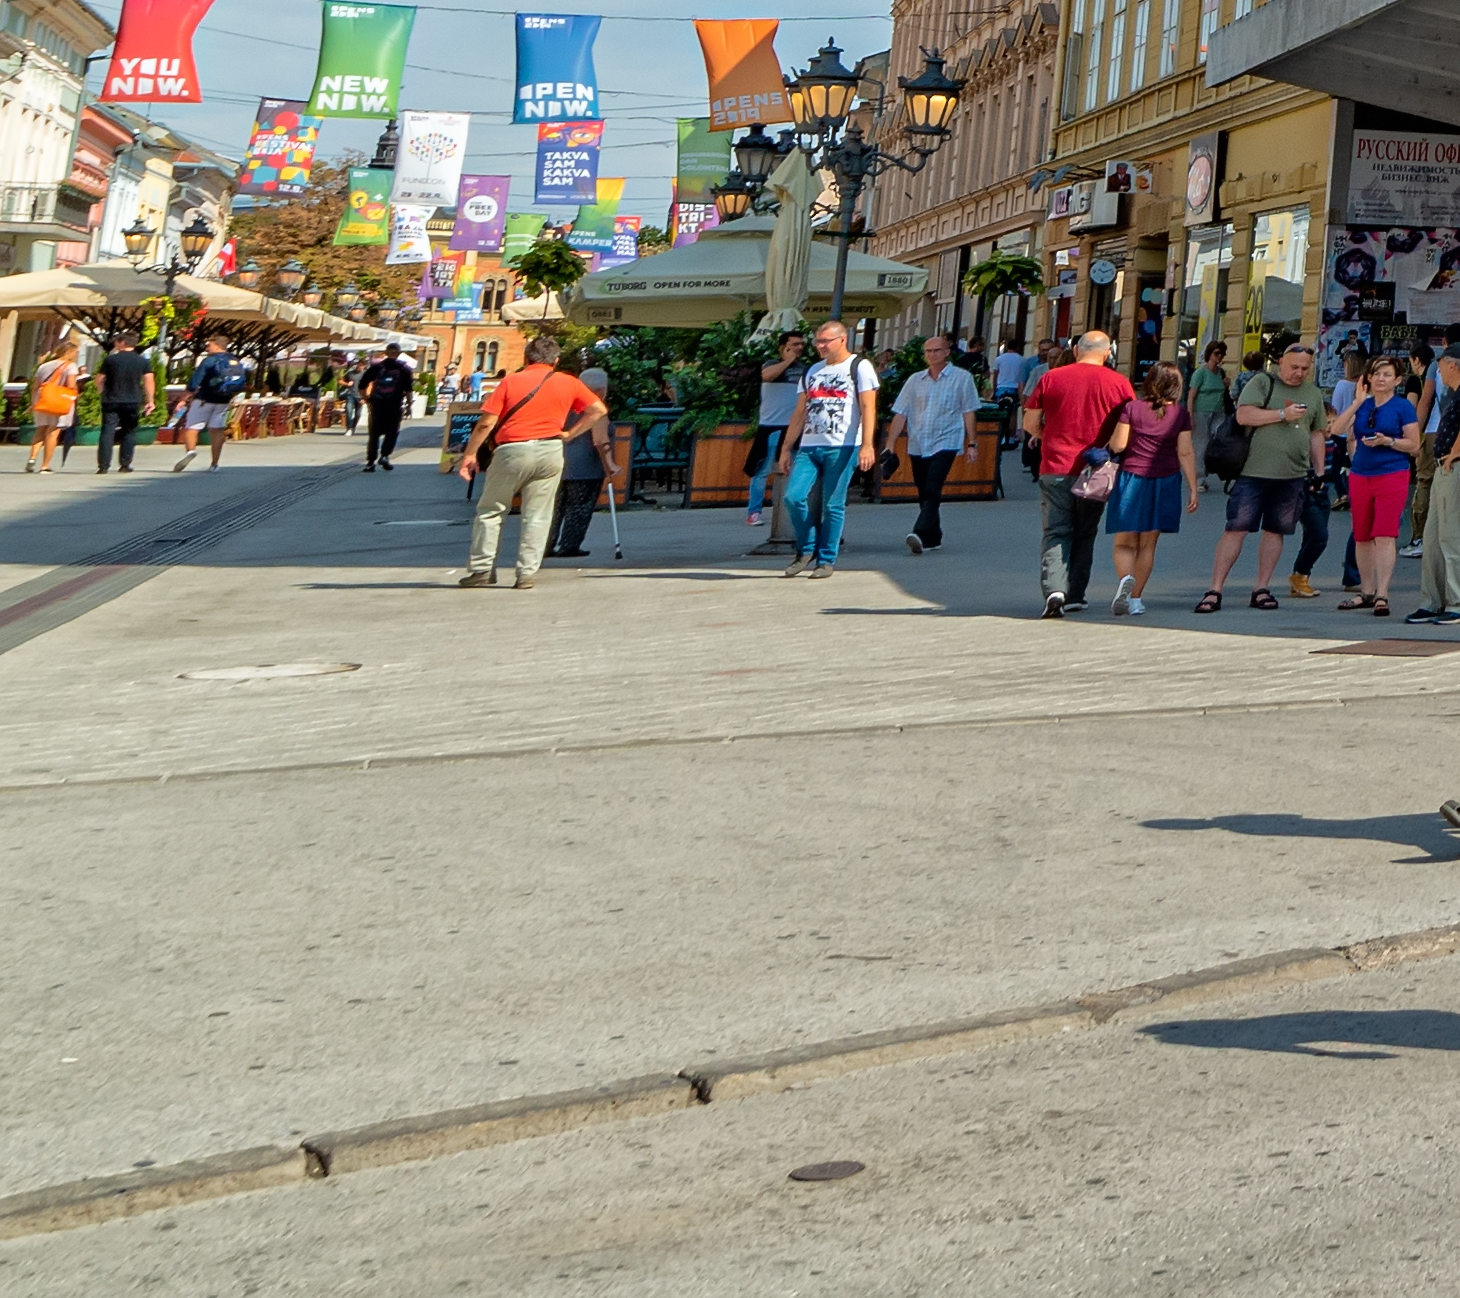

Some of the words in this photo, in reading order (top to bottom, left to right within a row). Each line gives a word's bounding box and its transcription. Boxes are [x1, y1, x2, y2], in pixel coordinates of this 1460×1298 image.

[119, 57, 181, 76] YOU
[109, 76, 190, 97] NOW.
[319, 74, 390, 94] NEW
[519, 82, 594, 101] OPEN
[316, 92, 391, 113] NOW.
[524, 100, 593, 118] NOW.
[712, 91, 784, 112] OPENS
[713, 107, 761, 126] 2019
[544, 151, 590, 161] TAKVA
[1356, 137, 1430, 162] РУССКИЙ
[542, 168, 591, 178] KAKVA
[543, 160, 576, 169] SAM
[1372, 163, 1460, 176] НЕДВИЖИМОСТЬ
[542, 177, 574, 186] SAM
[568, 237, 613, 247] KAMPER
[606, 281, 647, 291] TUBORG
[653, 281, 681, 289] OPEN
[682, 280, 701, 288] FOR
[703, 280, 731, 288] MORE
